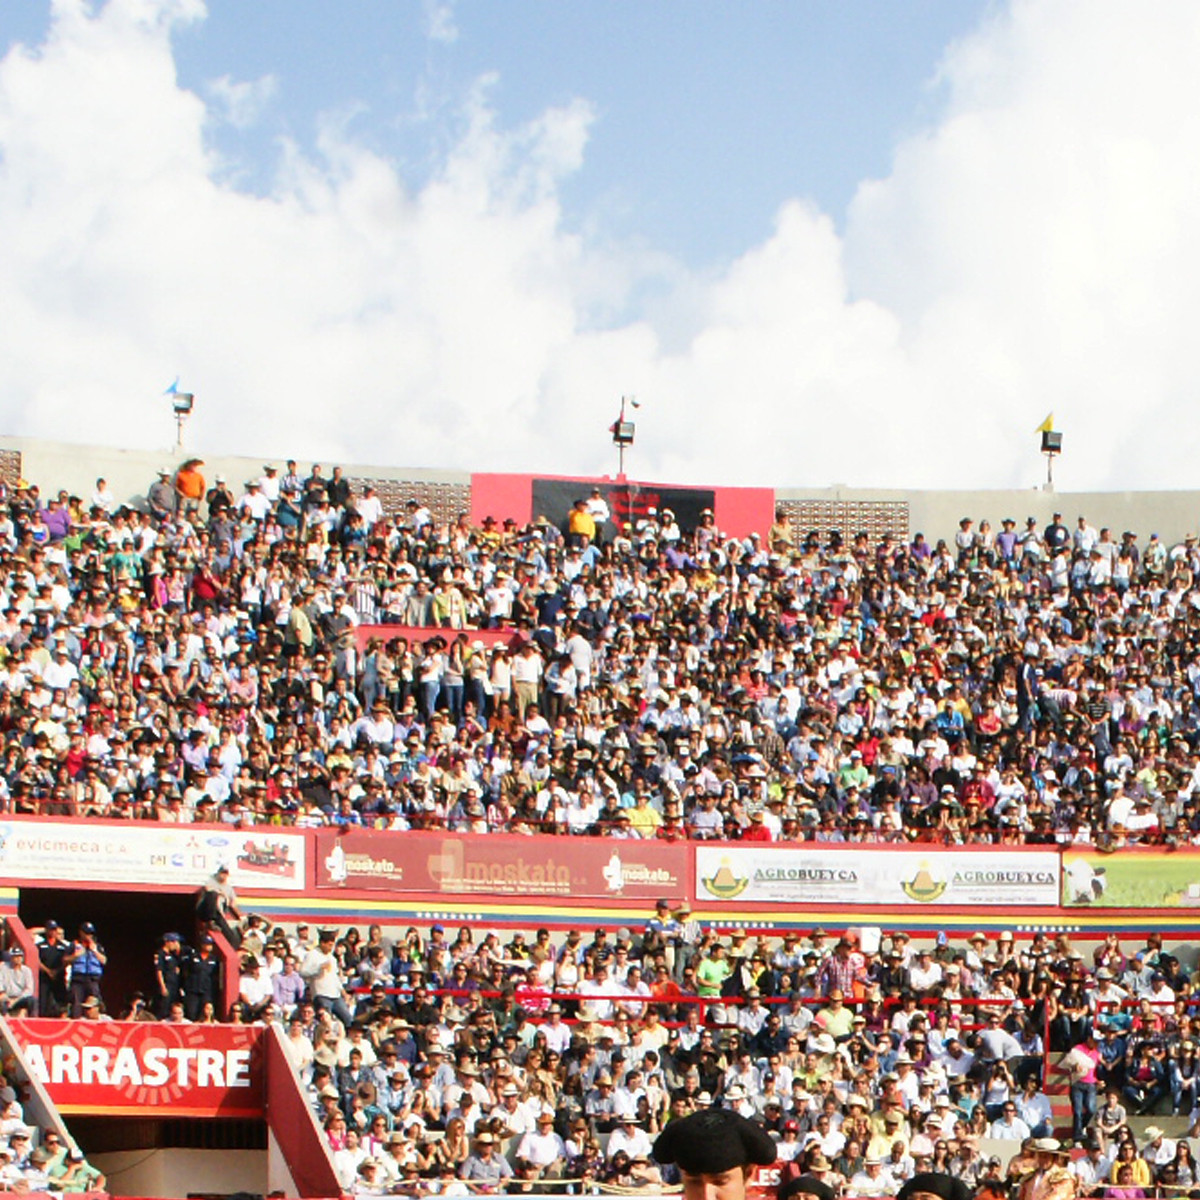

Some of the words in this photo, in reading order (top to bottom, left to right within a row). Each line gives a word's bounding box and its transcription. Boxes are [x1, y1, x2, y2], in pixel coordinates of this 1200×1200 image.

[754, 868, 858, 880] AGROBUEYCA
[953, 871, 1056, 884] AGROBUEYCA
[24, 1044, 250, 1087] ARRASTRE
